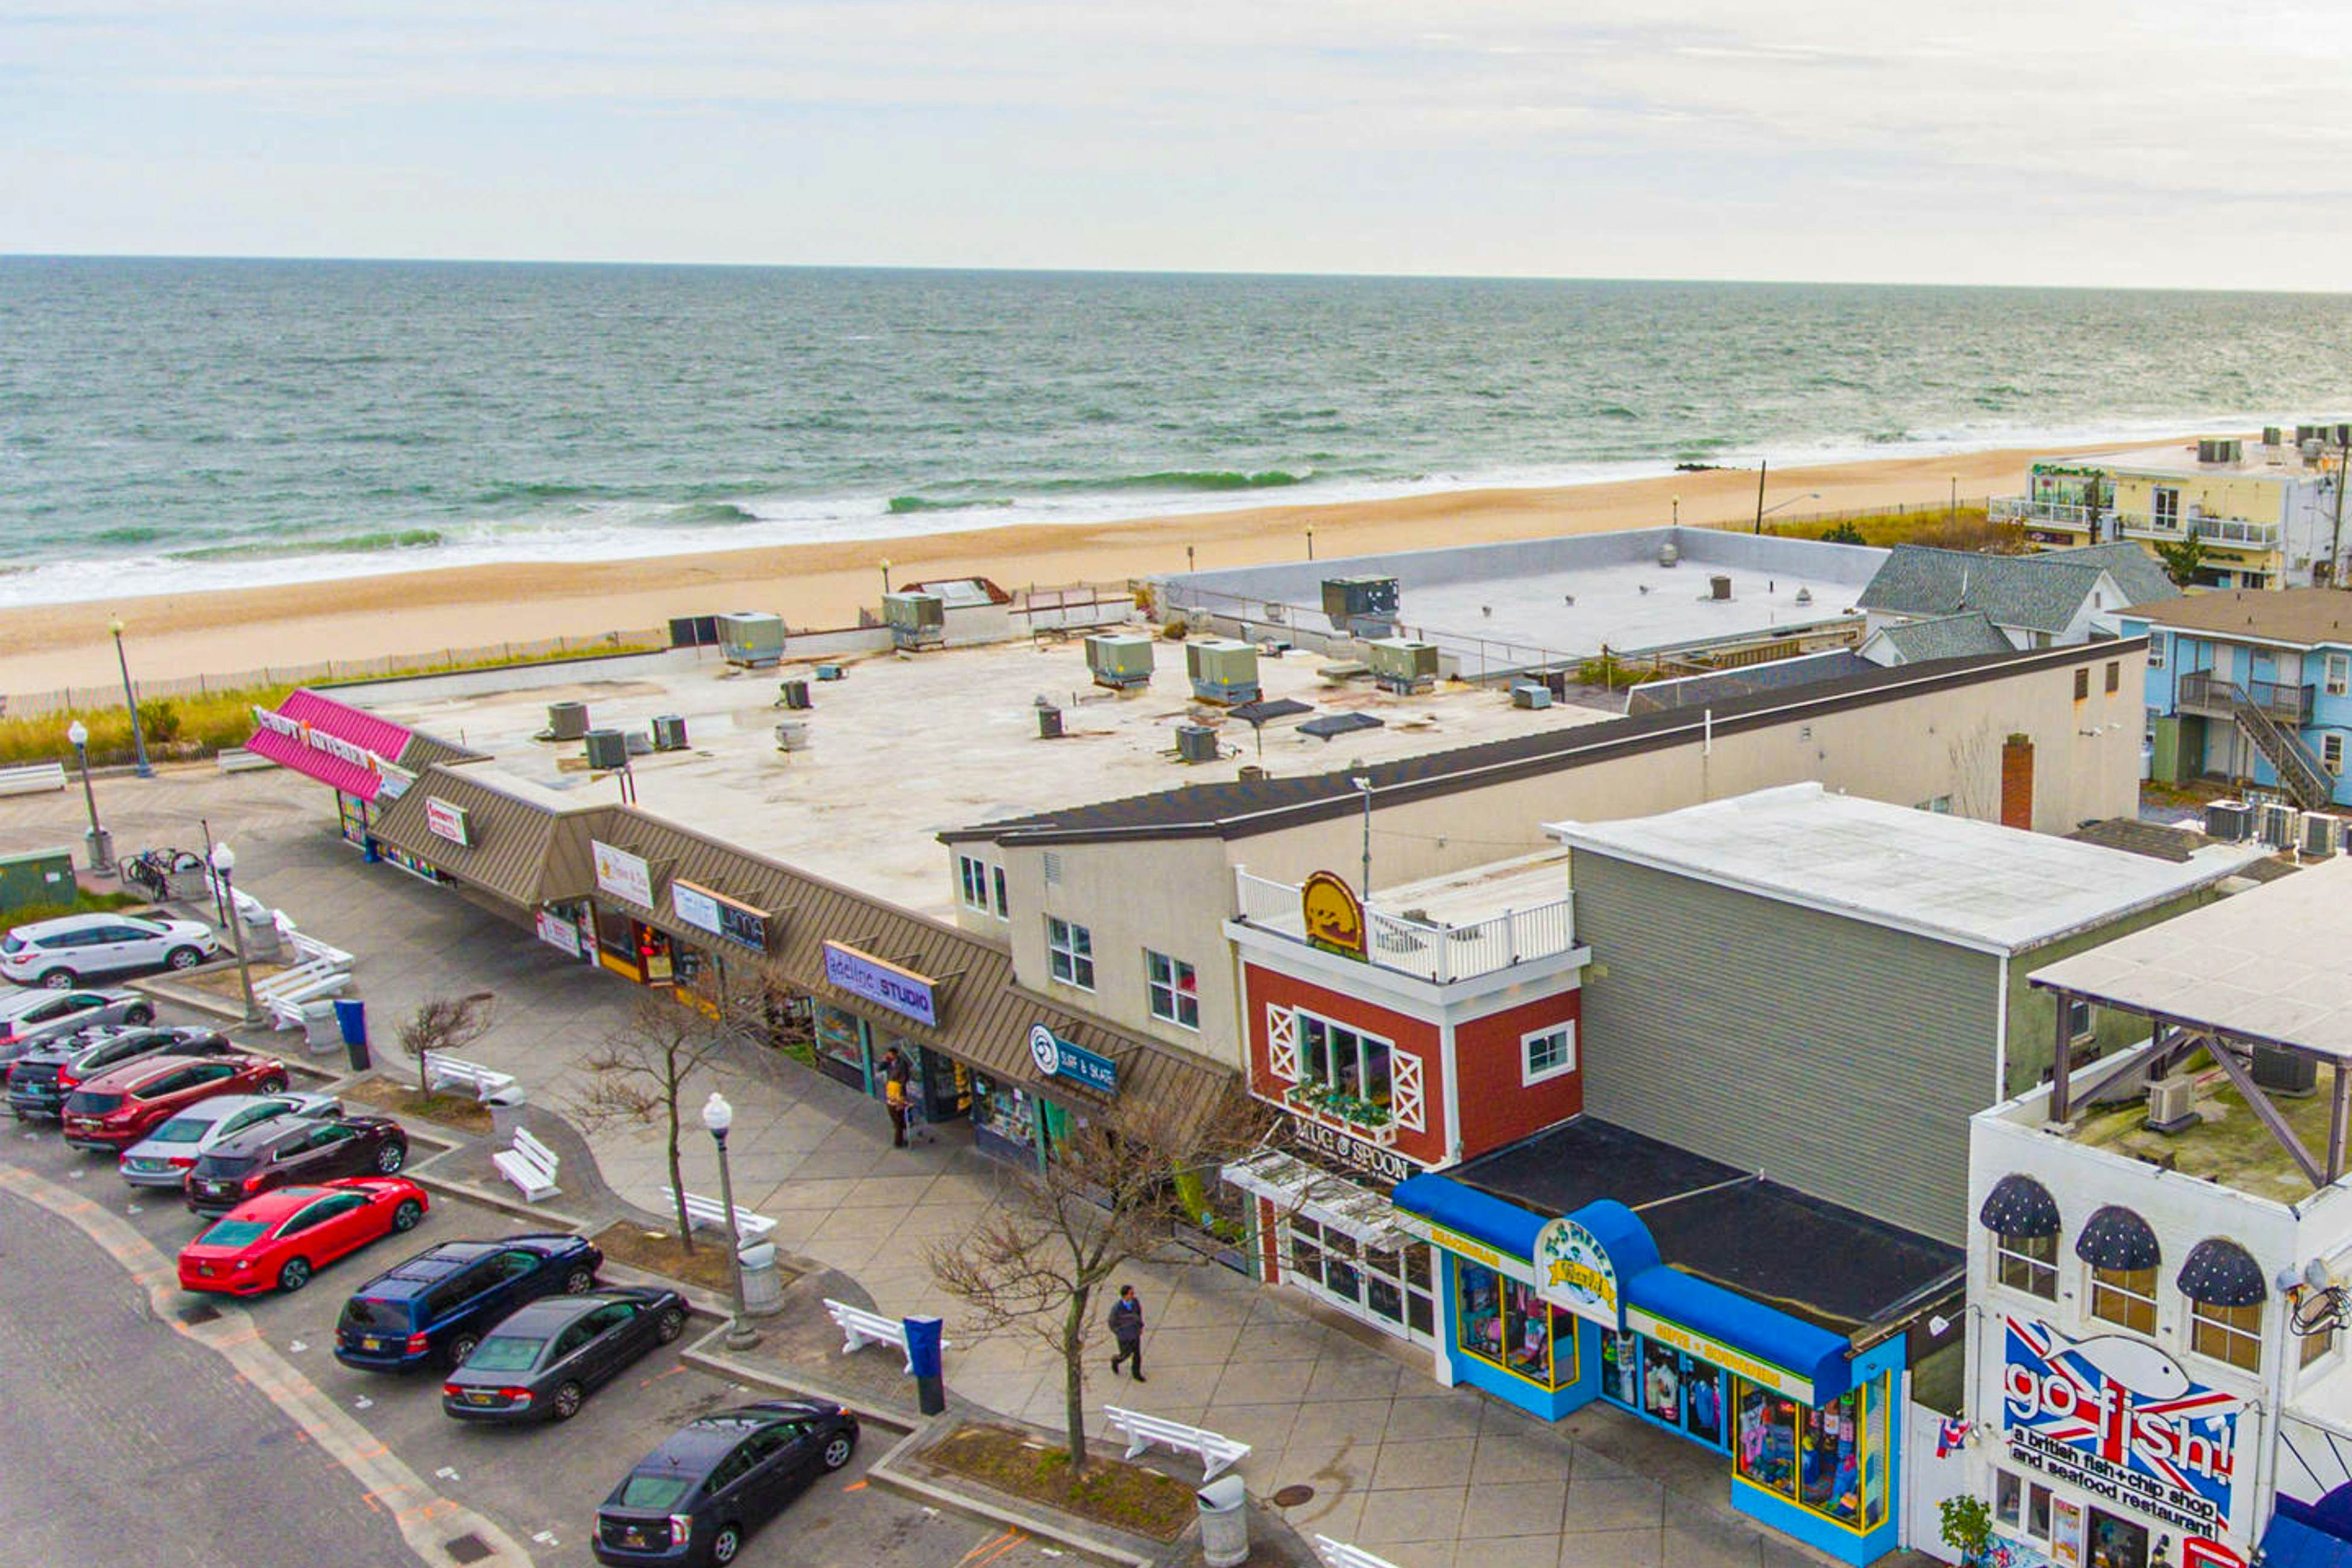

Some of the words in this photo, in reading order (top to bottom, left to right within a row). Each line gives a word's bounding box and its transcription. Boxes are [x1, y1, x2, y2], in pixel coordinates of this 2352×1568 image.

[880, 978, 930, 1013] STUDIO
[1351, 1140, 1408, 1181] SPOON
[2006, 1363, 2078, 1420] go
[2092, 1386, 2231, 1486] fish!
[2013, 1447, 2042, 1468] and
[2048, 1461, 2117, 1499] seafood
[2123, 1491, 2213, 1538] restaurant
[2014, 1429, 2024, 1442] a
[2029, 1429, 2078, 1464] british
[2169, 1490, 2214, 1518] shop
